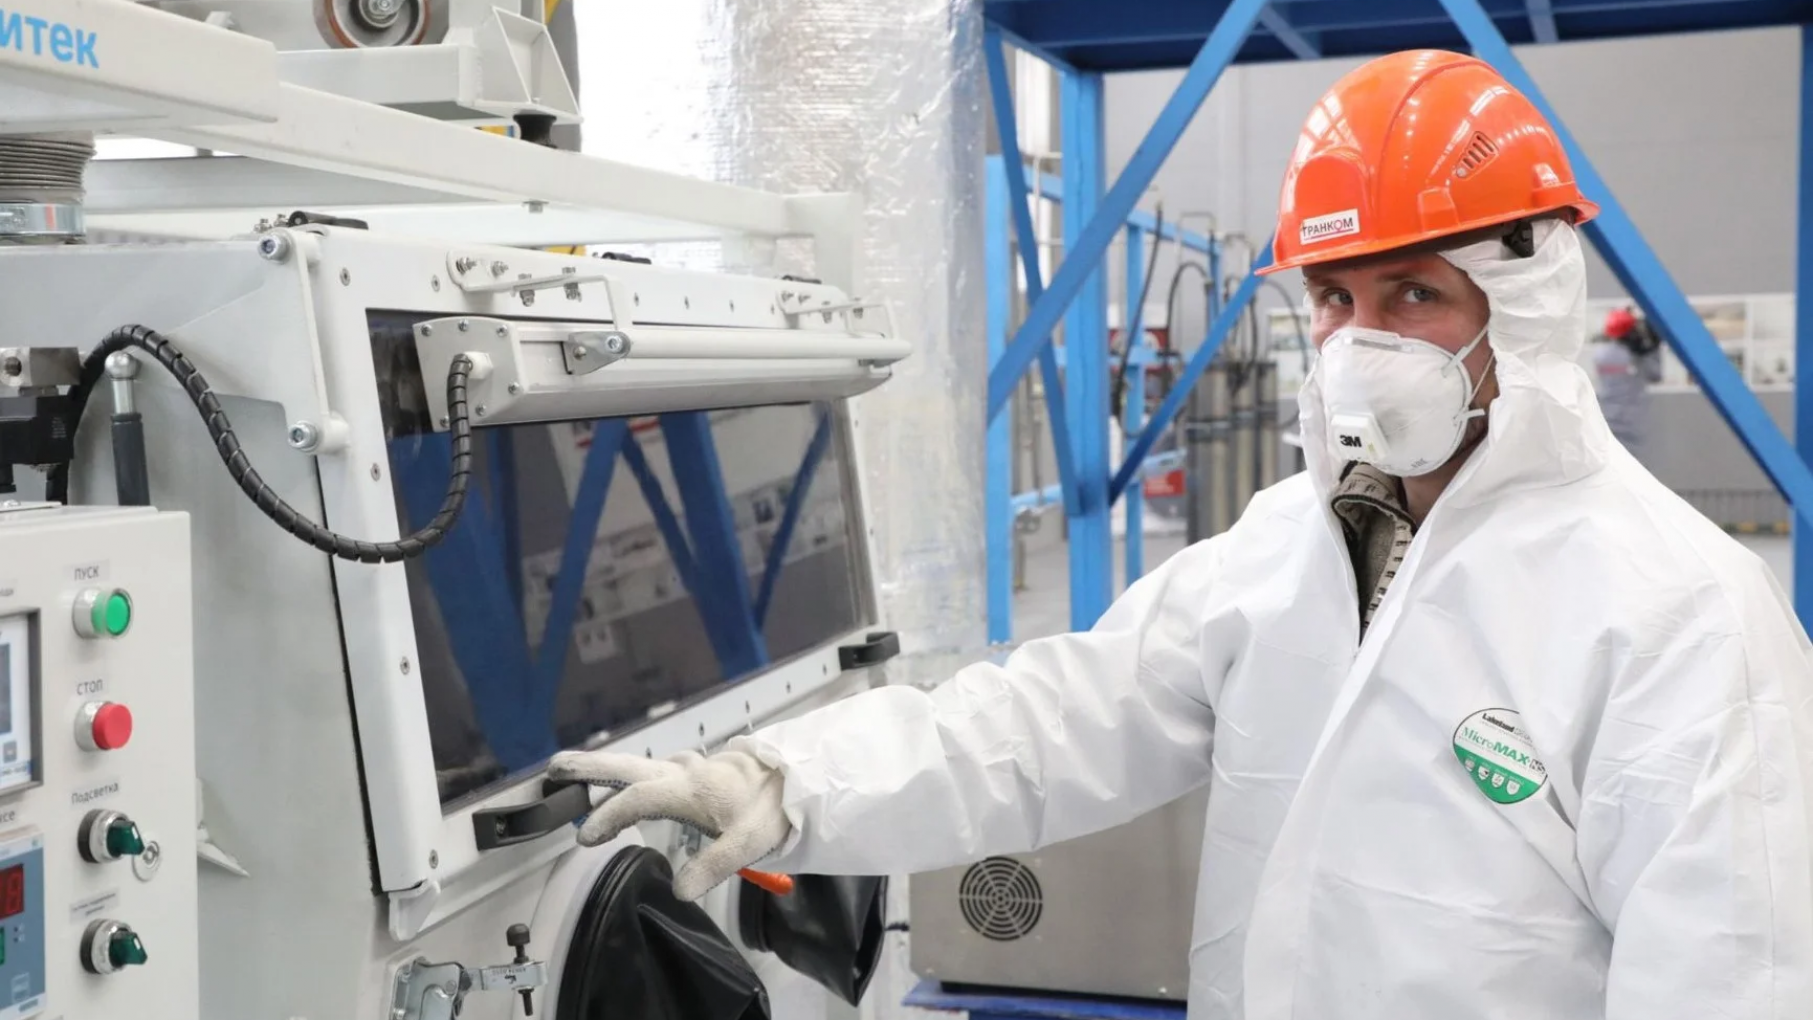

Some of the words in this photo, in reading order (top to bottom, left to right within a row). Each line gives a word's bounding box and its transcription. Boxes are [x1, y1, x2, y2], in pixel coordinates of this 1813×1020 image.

[1339, 434, 1362, 448] 3M
[74, 566, 100, 581] ПУСК
[77, 679, 103, 695] СТОП
[1463, 727, 1530, 766] MicroMAX
[71, 782, 119, 805] Подсветка
